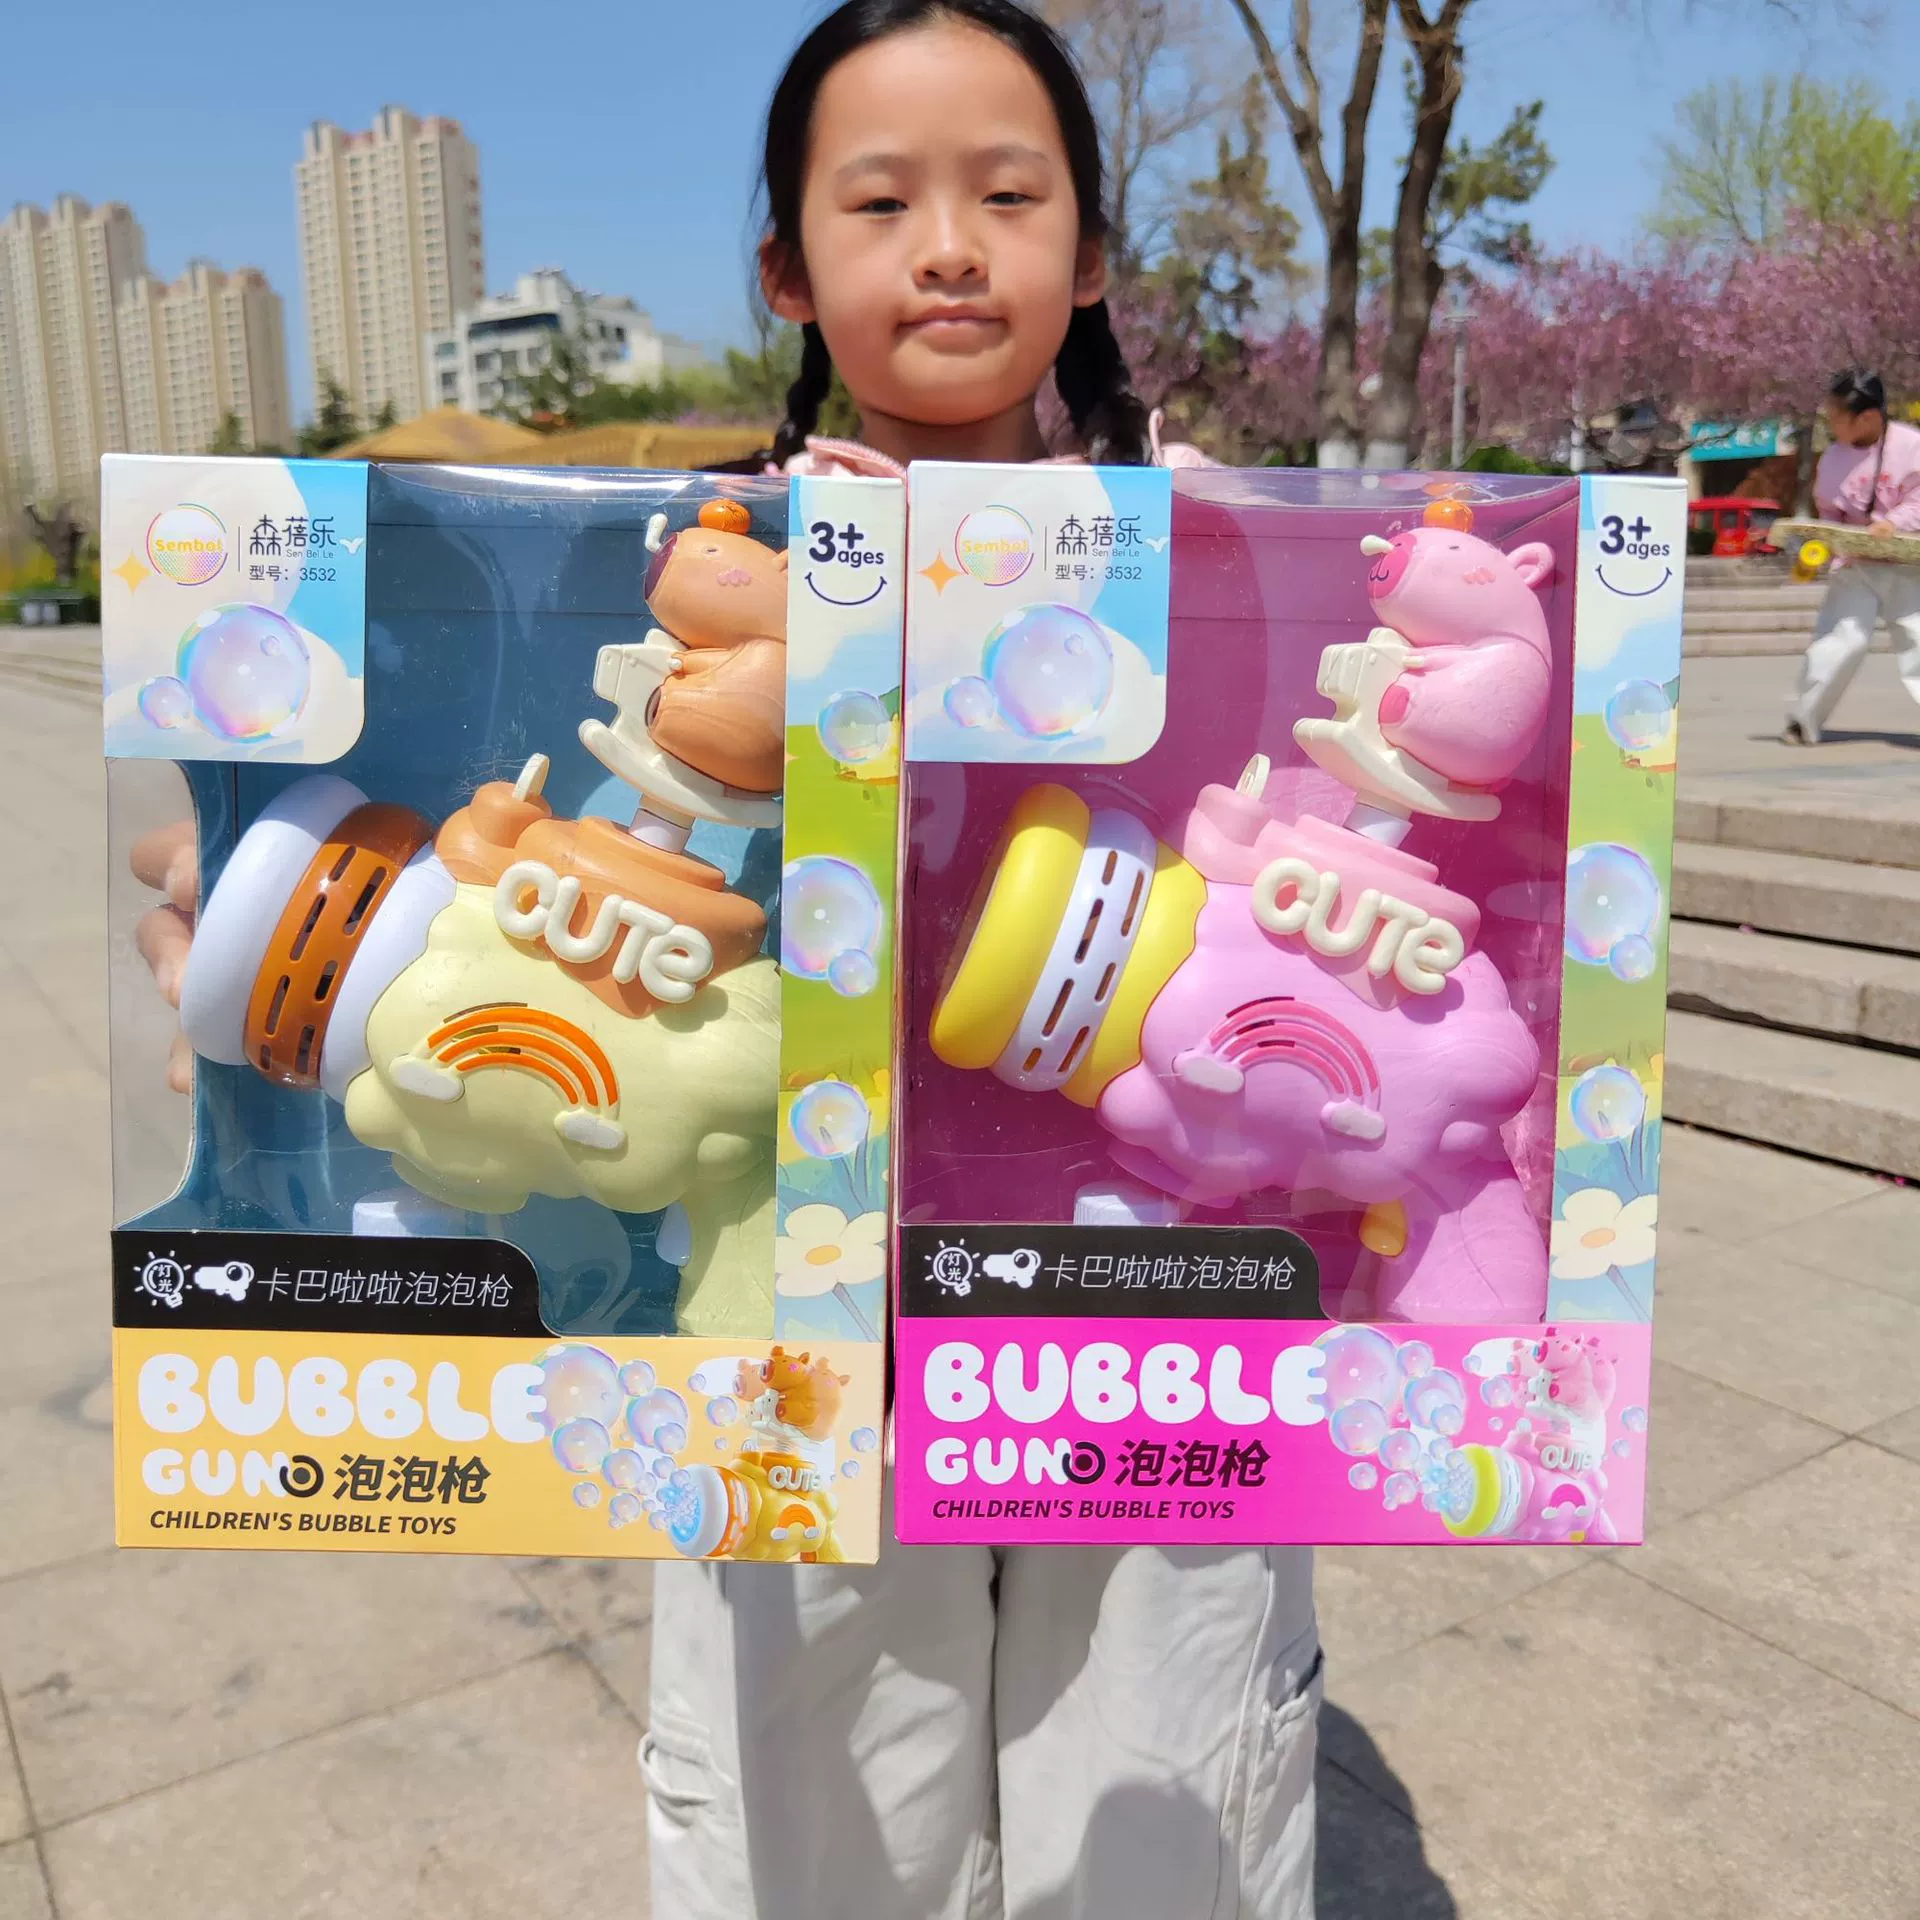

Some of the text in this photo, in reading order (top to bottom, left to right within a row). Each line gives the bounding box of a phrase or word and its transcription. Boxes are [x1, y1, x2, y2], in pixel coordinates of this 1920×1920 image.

[286, 548, 303, 559] Sen
[322, 549, 334, 559] Le
[837, 550, 885, 568] ages
[1091, 547, 1109, 557] Sen
[1128, 548, 1140, 557] Le
[1626, 539, 1670, 560] ages
[257, 1267, 513, 1307] 卡巴啦啦泡泡枪
[1044, 1253, 1296, 1291] 卡巴啦啦泡泡枪
[137, 1352, 547, 1443] BUBBLE
[923, 1341, 1328, 1426] BUBBLE
[332, 1453, 492, 1504] 泡泡枪
[1114, 1439, 1272, 1488] 泡泡枪
[149, 1509, 457, 1535] CHILDREN'S BUBBLE TOYS
[932, 1499, 1235, 1519] CHILDREN'S BUBBLE TOYS
